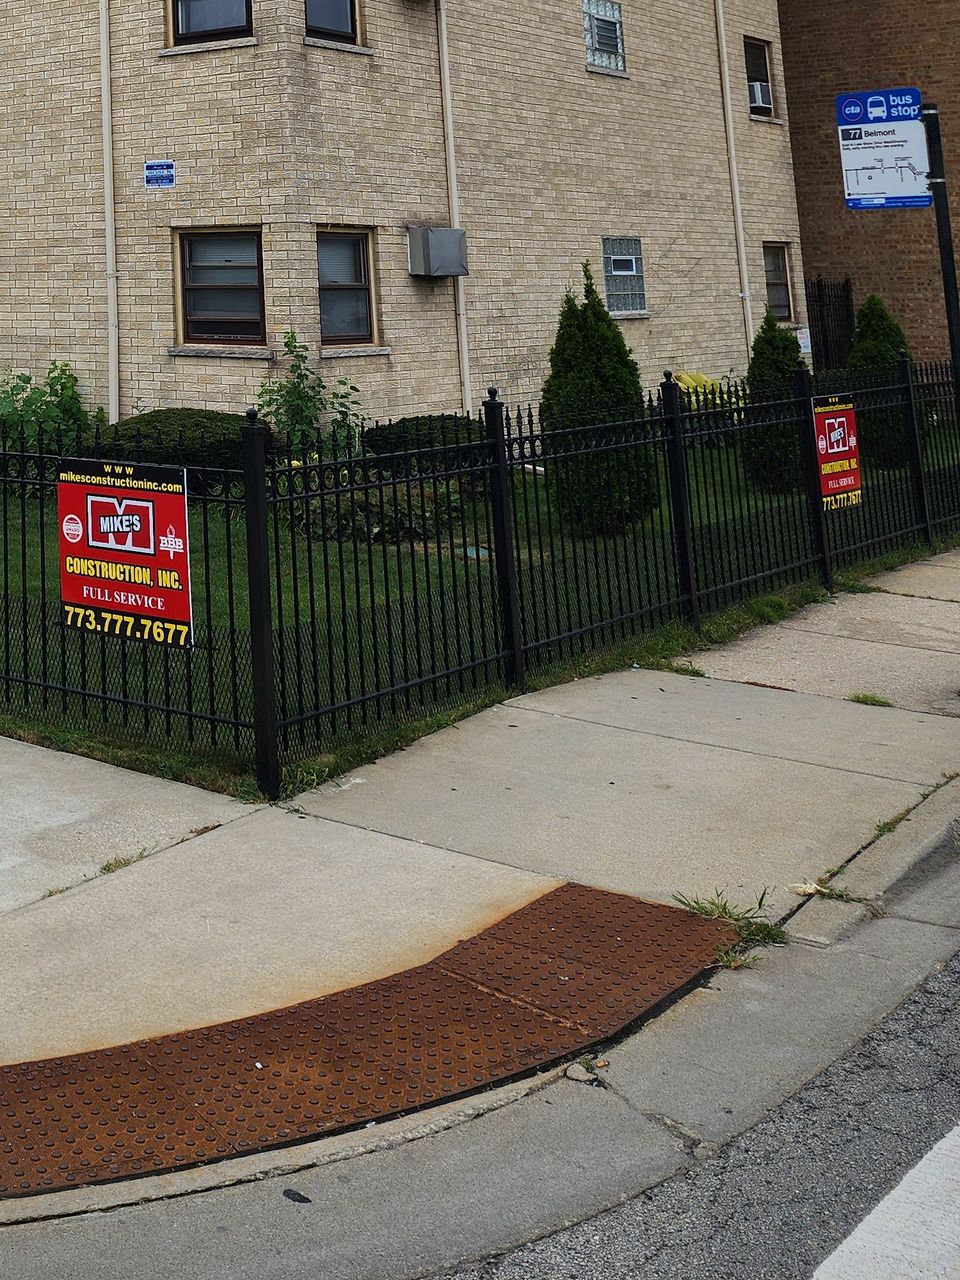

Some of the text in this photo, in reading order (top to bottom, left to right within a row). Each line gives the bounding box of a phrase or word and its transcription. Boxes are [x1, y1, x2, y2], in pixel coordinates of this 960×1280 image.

[889, 94, 913, 105] bus
[845, 106, 860, 114] cta
[890, 105, 919, 118] stop
[848, 129, 896, 138] 77 Belmont
[59, 471, 183, 493] mikesconstructioninc.com
[828, 476, 855, 489] FULL SERVICE
[822, 489, 862, 511] 773.777.7677
[100, 514, 141, 533] MIKE'S
[159, 536, 183, 550] BBB
[65, 556, 183, 590] CONSTRUCTION, INC.
[82, 585, 166, 610] FULL SERVICE
[64, 605, 189, 646] 773.777.7677
